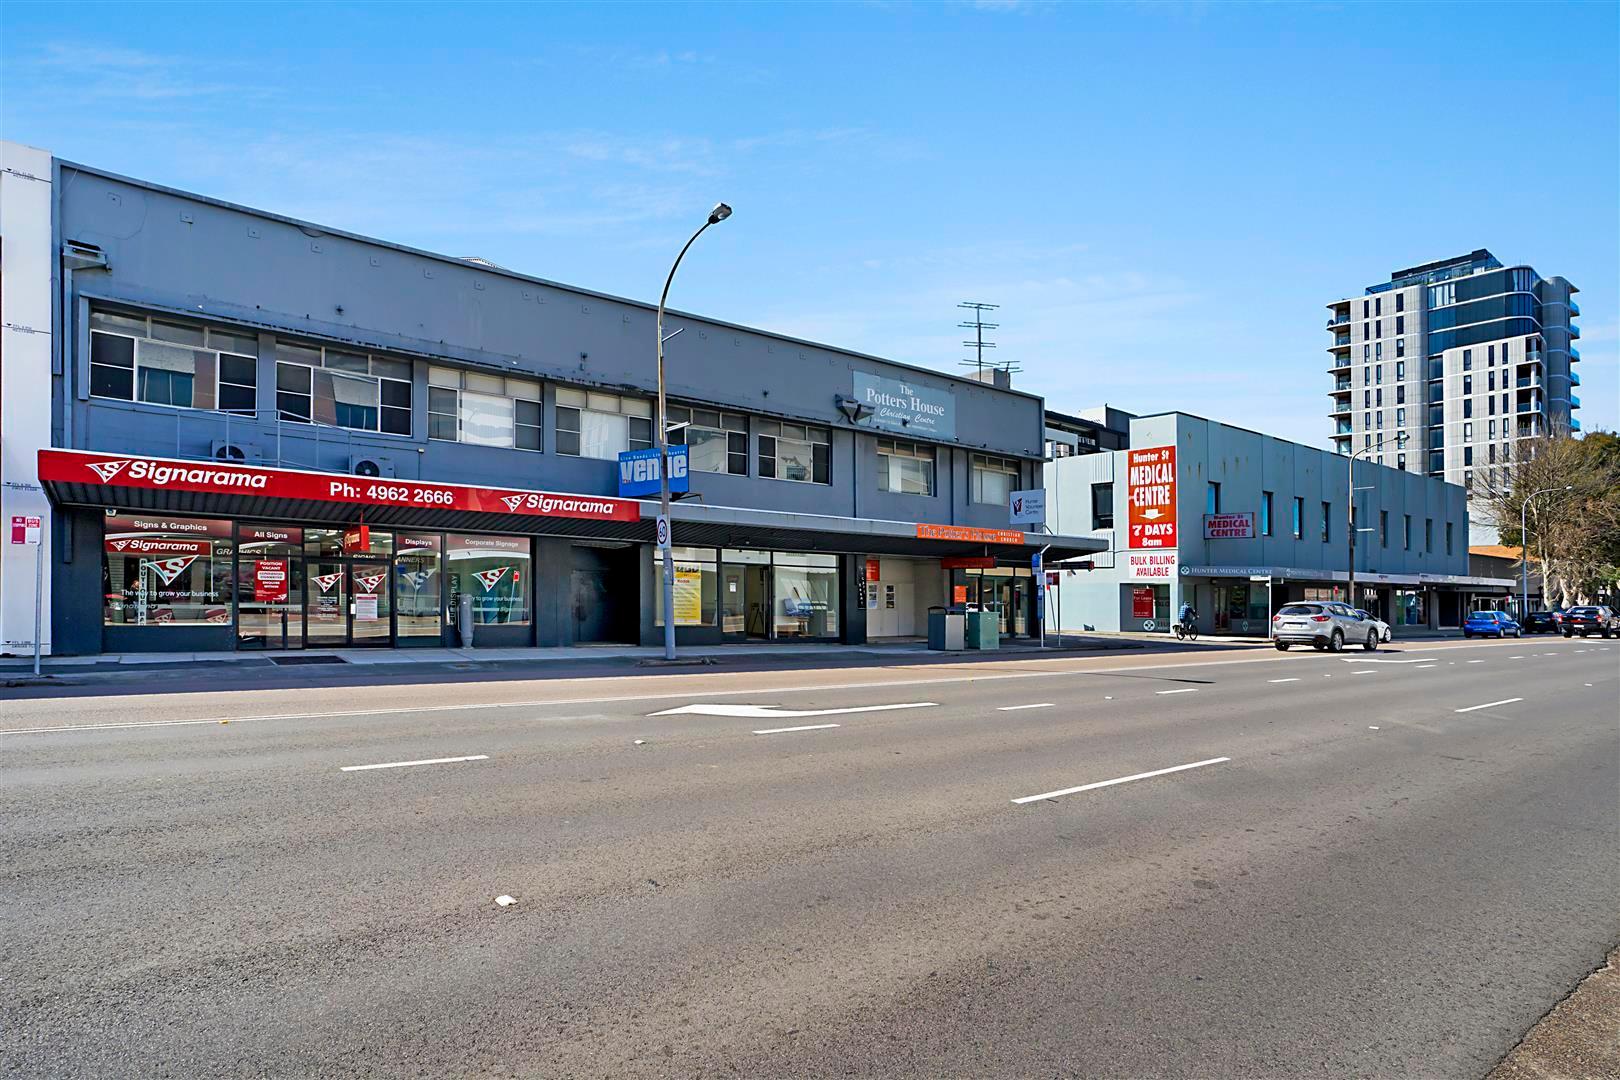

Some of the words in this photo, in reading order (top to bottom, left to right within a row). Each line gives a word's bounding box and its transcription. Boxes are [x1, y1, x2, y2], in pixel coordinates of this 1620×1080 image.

[900, 384, 914, 396] The
[866, 388, 907, 409] Potters
[911, 397, 945, 416] House
[880, 407, 911, 420] Christian
[914, 413, 935, 425] Centre
[1133, 453, 1158, 463] Hunter
[1161, 450, 1169, 460] St
[128, 461, 267, 488] Signarama
[1130, 463, 1173, 486] MEDICAL
[330, 482, 361, 498] Ph:
[366, 485, 408, 501] 4962
[413, 489, 453, 504] 2666
[1133, 485, 1170, 507] CENTRE
[526, 494, 614, 514] Signarama
[134, 520, 159, 529] Signs
[169, 523, 207, 531] Graphics
[1132, 525, 1142, 536] 7
[1145, 524, 1173, 536] DAYS
[1208, 520, 1250, 528] MEDICAL
[1210, 529, 1247, 537] CENTRE
[130, 539, 198, 552] Signarama
[405, 538, 432, 546] Displays
[465, 539, 495, 547] Corporate
[495, 540, 519, 548] Signage
[1142, 538, 1162, 546] 8am
[1130, 556, 1147, 565] BULK
[1149, 555, 1175, 565] BILLING
[1136, 567, 1169, 576] AVAILABLE
[159, 590, 175, 598] grow
[176, 590, 190, 599] your
